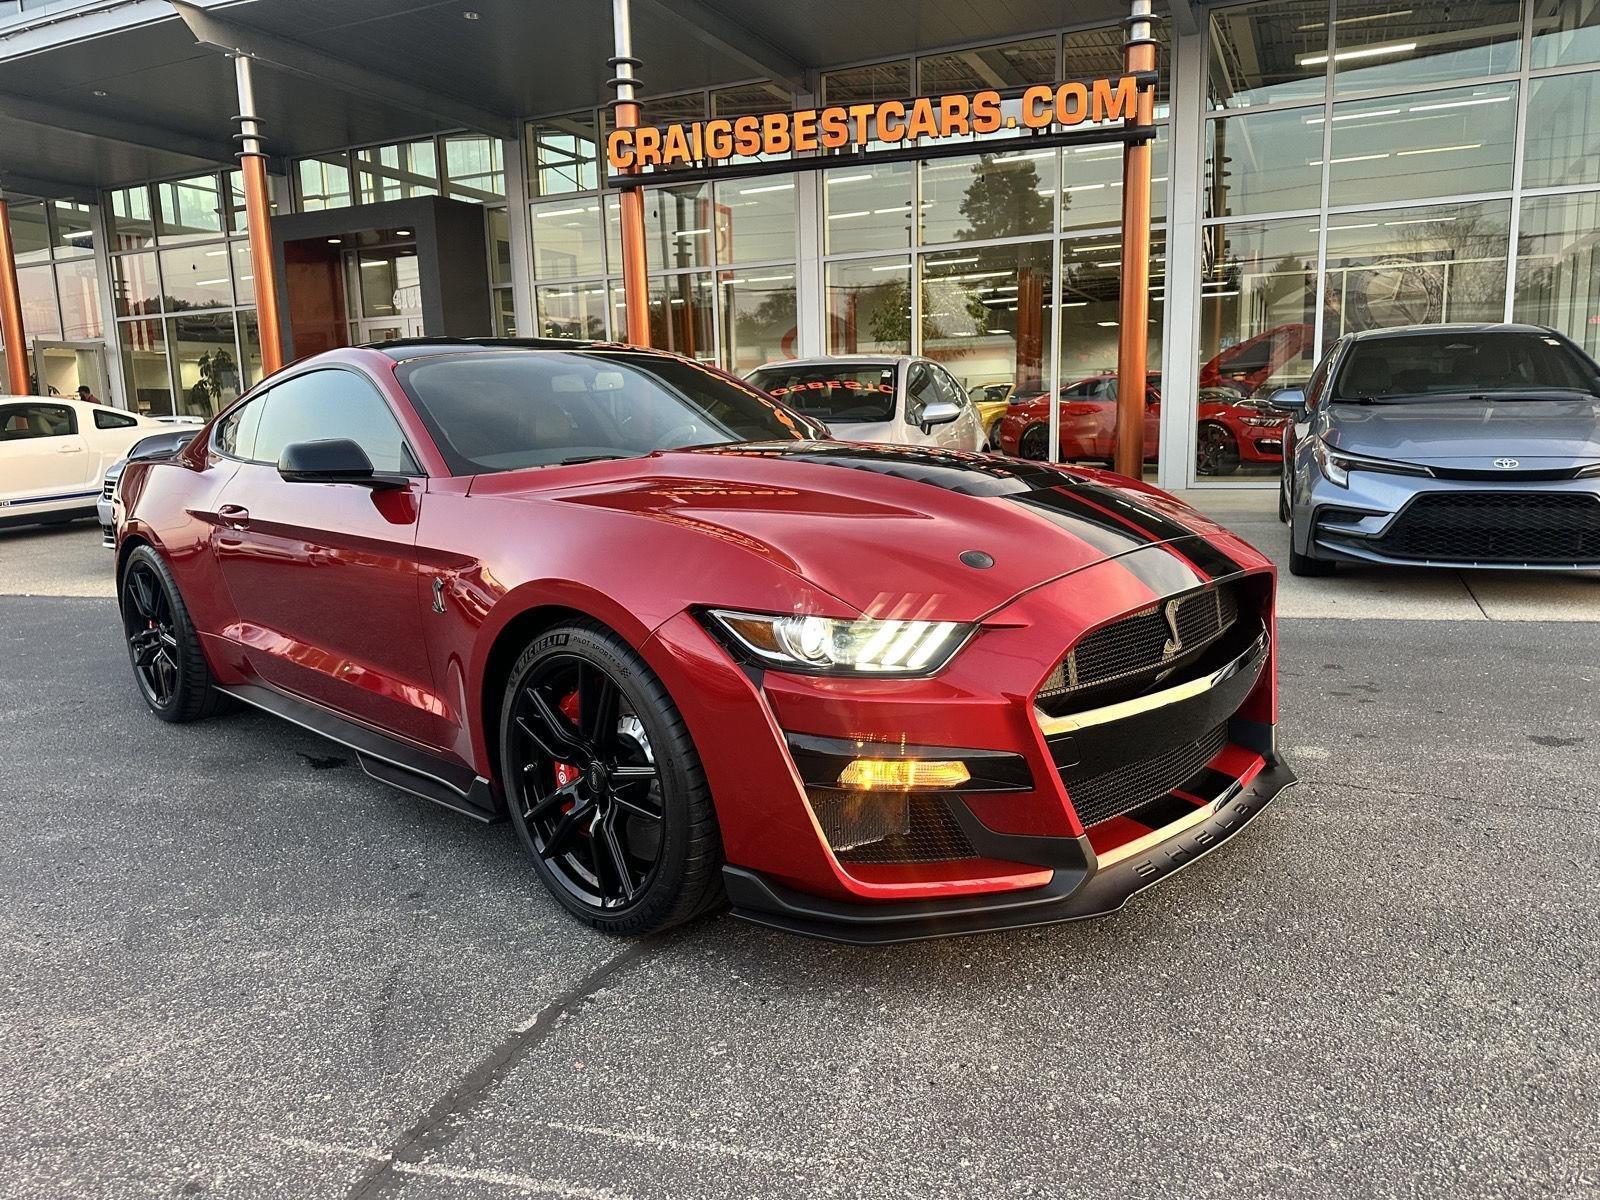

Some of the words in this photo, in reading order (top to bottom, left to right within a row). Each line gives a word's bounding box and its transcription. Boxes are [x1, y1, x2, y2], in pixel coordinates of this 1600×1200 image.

[607, 76, 1138, 169] CRAIGSBESTCARS.COM
[517, 633, 568, 672] MICHELIN
[573, 636, 591, 646] PILOT
[591, 643, 613, 660] SPORT
[1132, 788, 1263, 878] SHELBY
